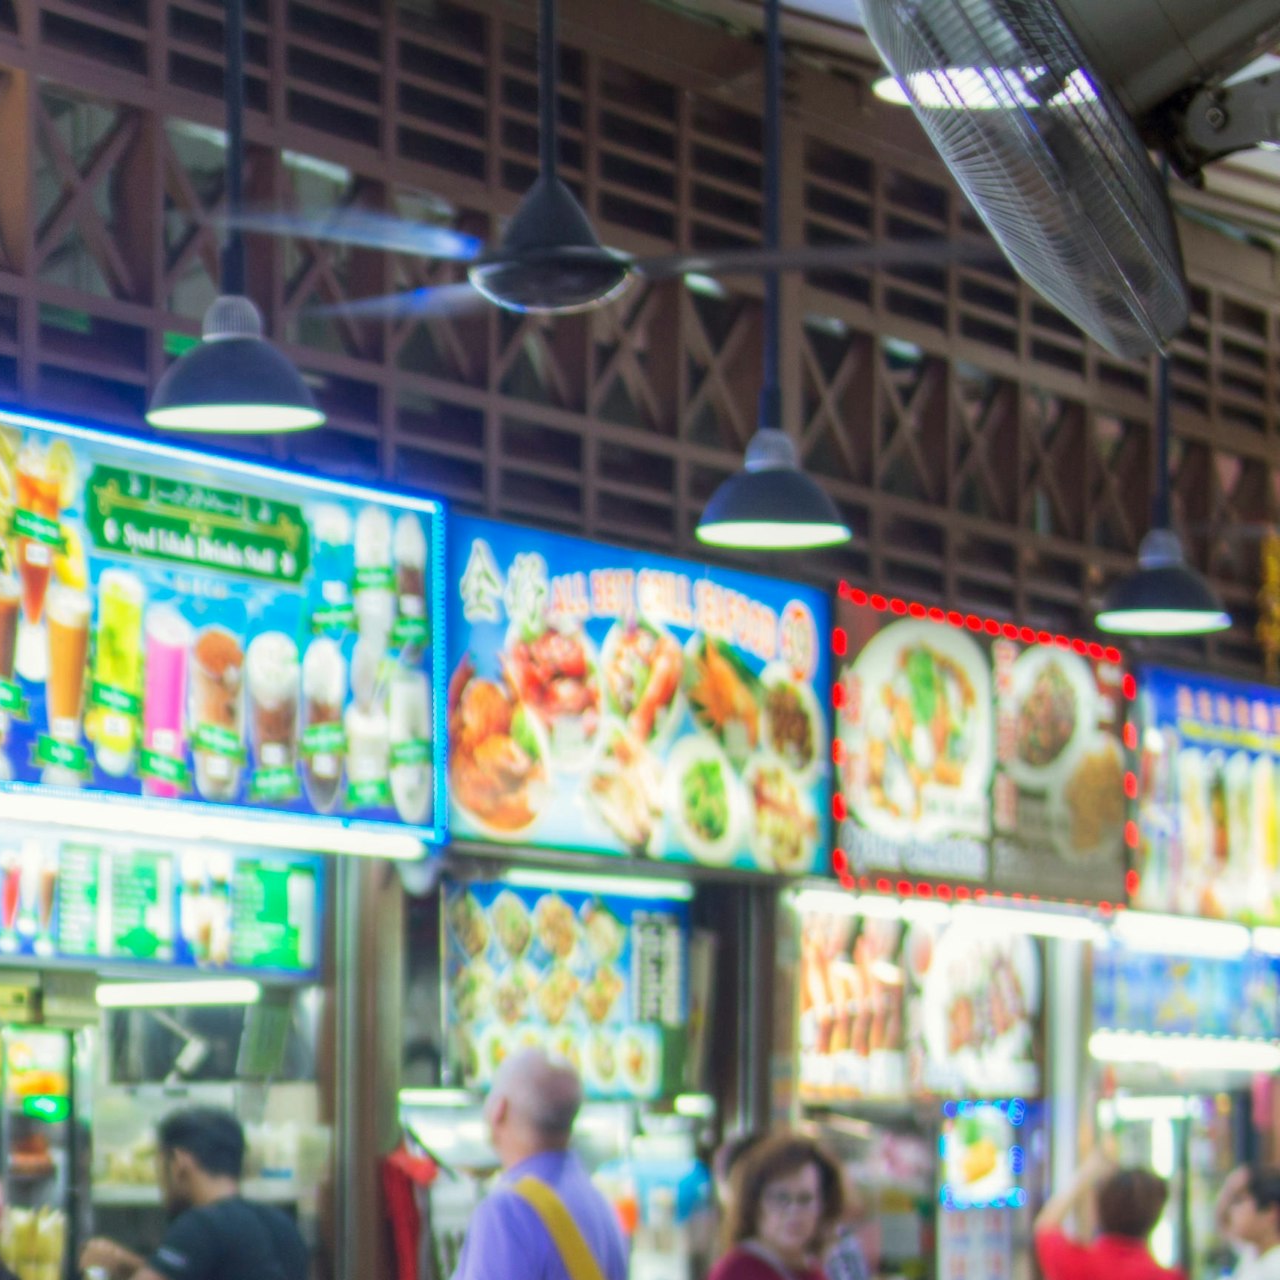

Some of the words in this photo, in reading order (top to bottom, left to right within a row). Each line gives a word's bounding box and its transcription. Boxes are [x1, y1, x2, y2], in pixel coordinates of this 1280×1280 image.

[123, 522, 158, 555] Syed
[197, 535, 244, 569] Drinks
[243, 544, 277, 574] Stall
[550, 571, 590, 615] ALL
